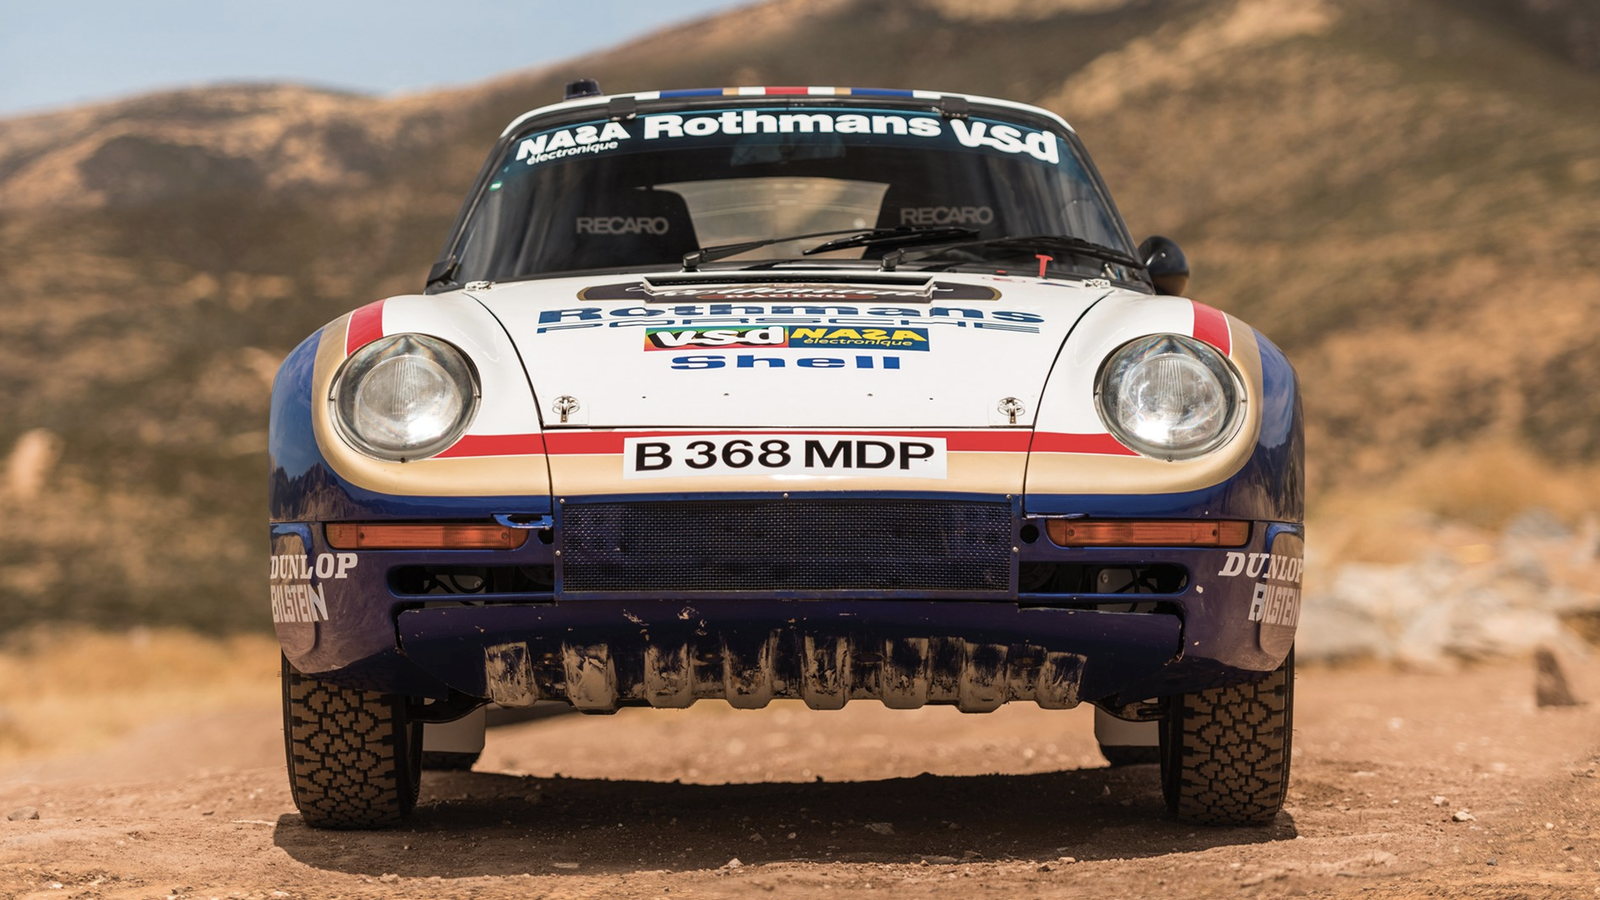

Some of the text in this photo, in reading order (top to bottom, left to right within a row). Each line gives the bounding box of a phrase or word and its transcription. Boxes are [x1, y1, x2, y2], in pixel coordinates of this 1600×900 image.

[644, 110, 942, 140] Rothmans
[576, 216, 669, 235] RECARO
[900, 206, 995, 225] RECARO
[537, 317, 1040, 334] PORSCHE
[538, 304, 1045, 324] Rothmans
[671, 354, 901, 370] Shell
[635, 439, 935, 472] B 368 MDP
[270, 552, 359, 580] DUNLOP
[1217, 551, 1304, 583] DUNLOP
[270, 582, 329, 623] BILSTEIN
